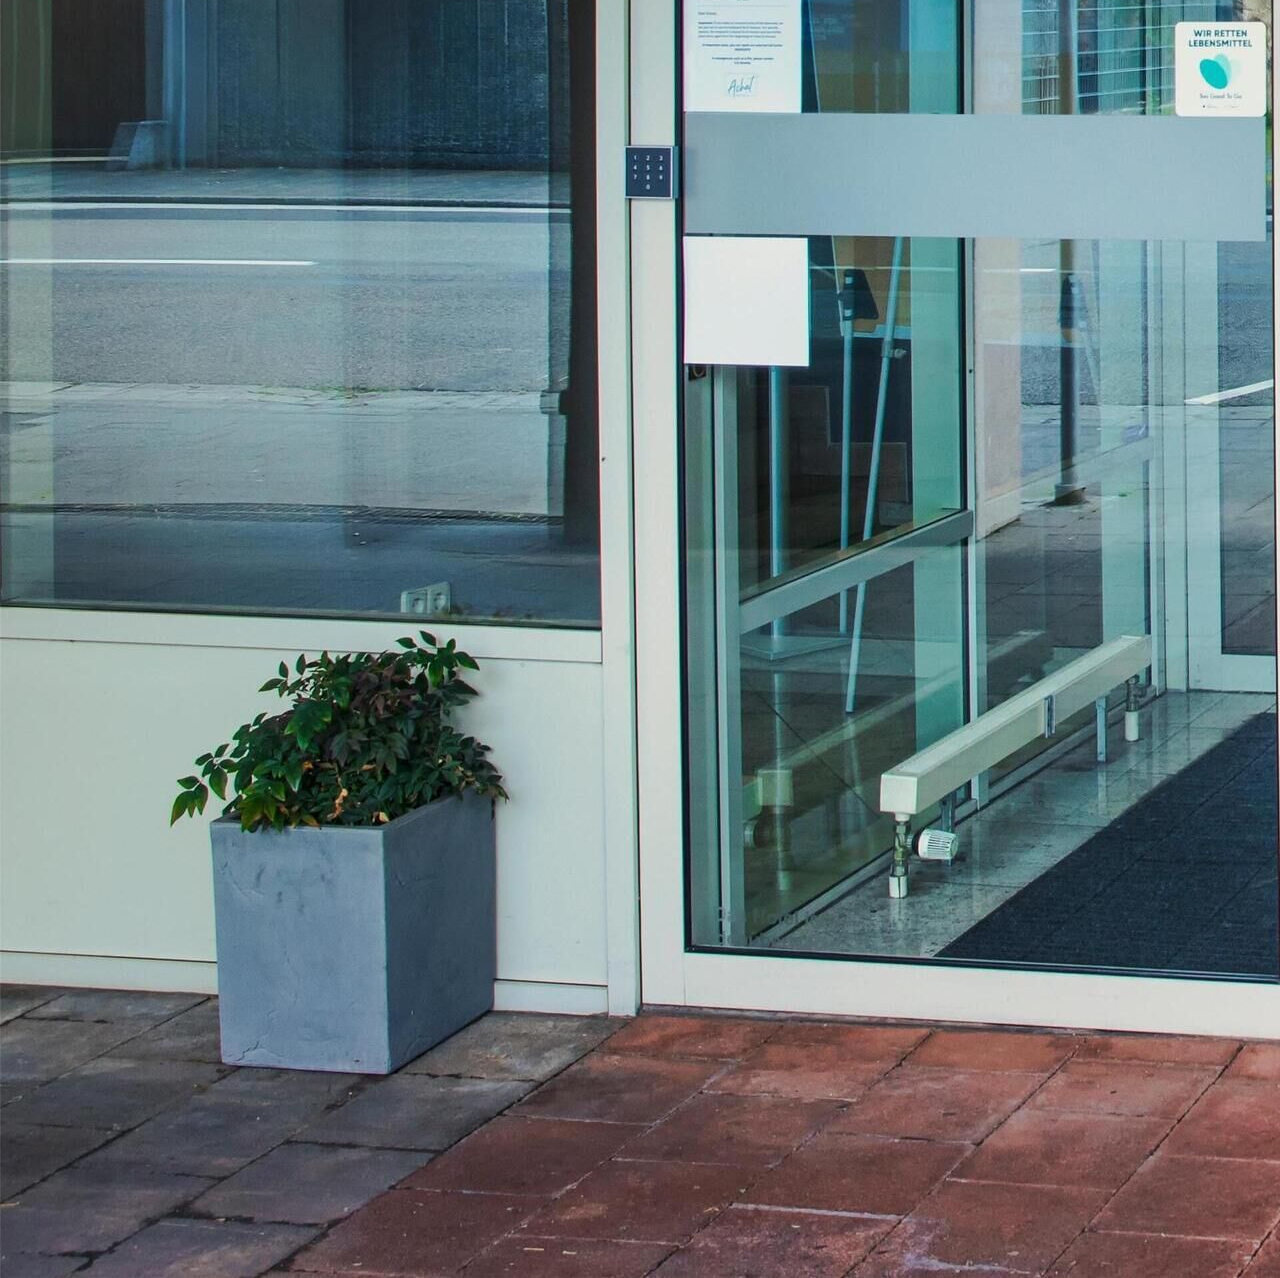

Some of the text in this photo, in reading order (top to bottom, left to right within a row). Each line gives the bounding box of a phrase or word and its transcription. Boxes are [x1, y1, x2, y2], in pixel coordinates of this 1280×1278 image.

[1193, 29, 1248, 37] WIR RETTEN
[1188, 39, 1253, 48] LEBENSMITTEL
[727, 73, 759, 98] Achat
